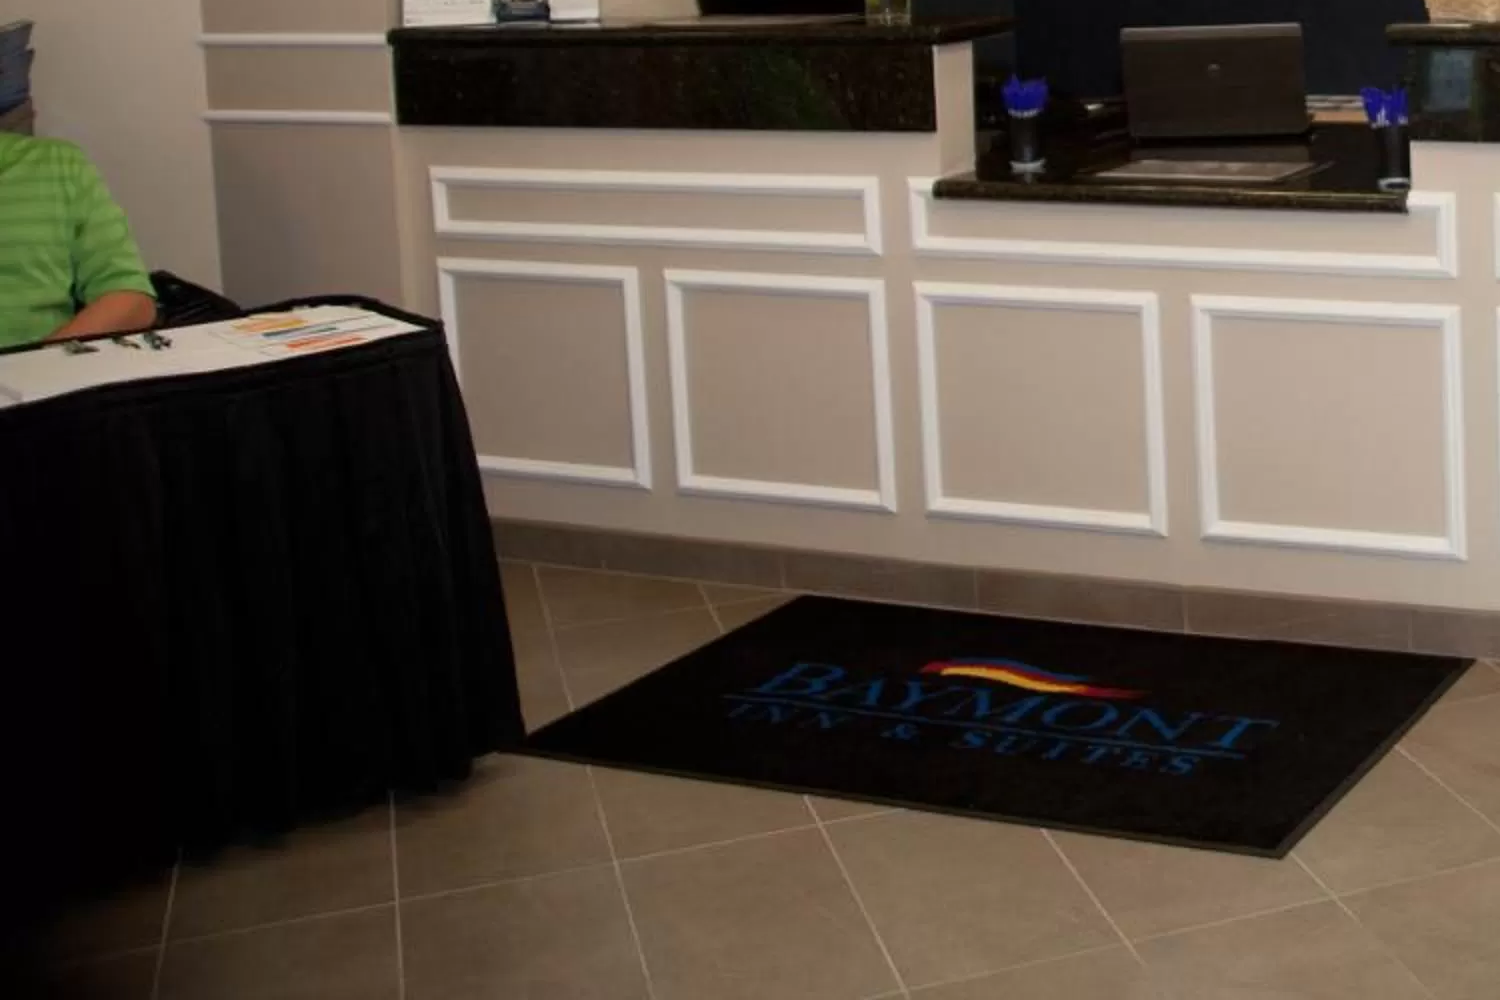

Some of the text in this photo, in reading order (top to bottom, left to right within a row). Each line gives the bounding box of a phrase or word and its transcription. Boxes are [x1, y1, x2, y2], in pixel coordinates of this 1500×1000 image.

[726, 702, 846, 730] INN
[951, 730, 1203, 777] SUITES
[743, 661, 1279, 750] BAYMONT
